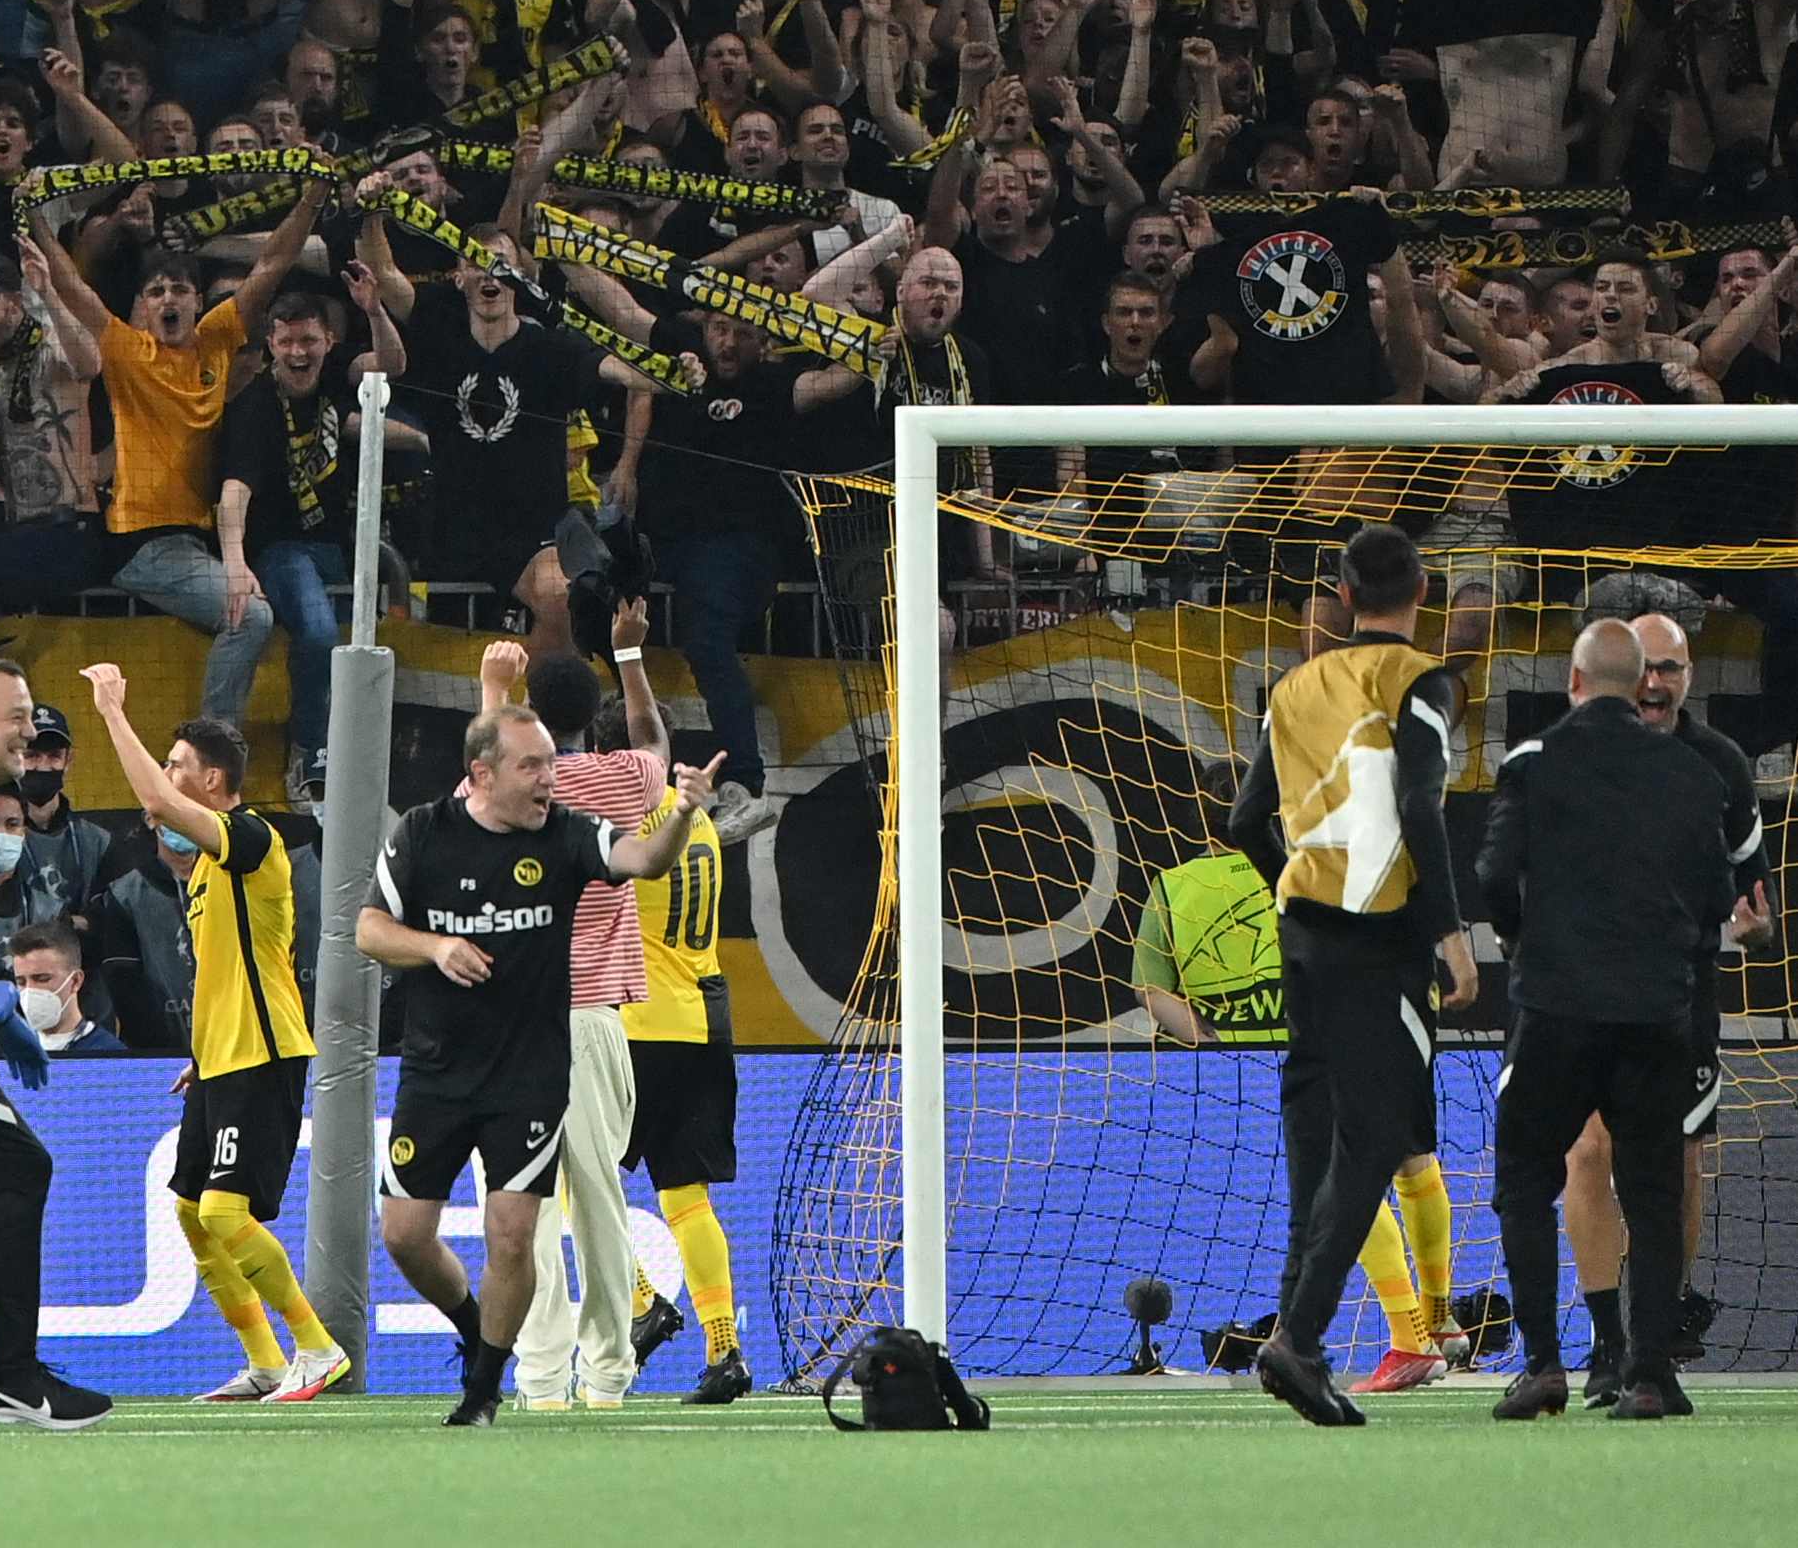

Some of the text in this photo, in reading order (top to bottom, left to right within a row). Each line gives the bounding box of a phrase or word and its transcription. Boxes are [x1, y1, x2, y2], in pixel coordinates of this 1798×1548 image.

[1247, 236, 1320, 274] ultras
[664, 843, 716, 950] 10
[427, 901, 554, 934] Plus500
[212, 1126, 238, 1164] 16
